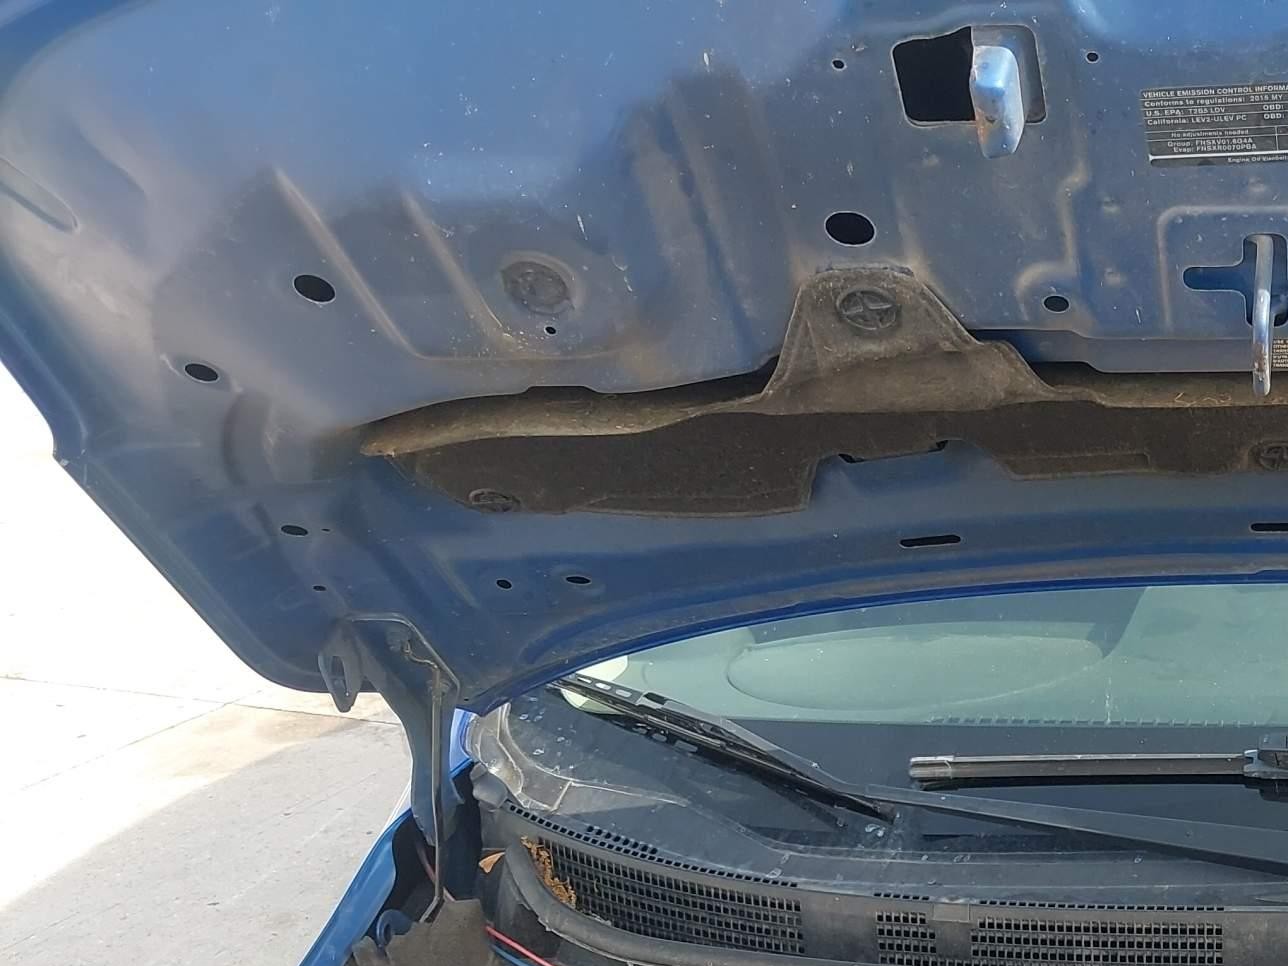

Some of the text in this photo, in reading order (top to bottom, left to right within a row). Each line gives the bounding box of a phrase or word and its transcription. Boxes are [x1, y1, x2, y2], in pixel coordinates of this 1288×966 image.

[1196, 97, 1245, 106] regulations:
[1147, 118, 1189, 126] California:
[1191, 115, 1234, 124] LEV2-ULEV
